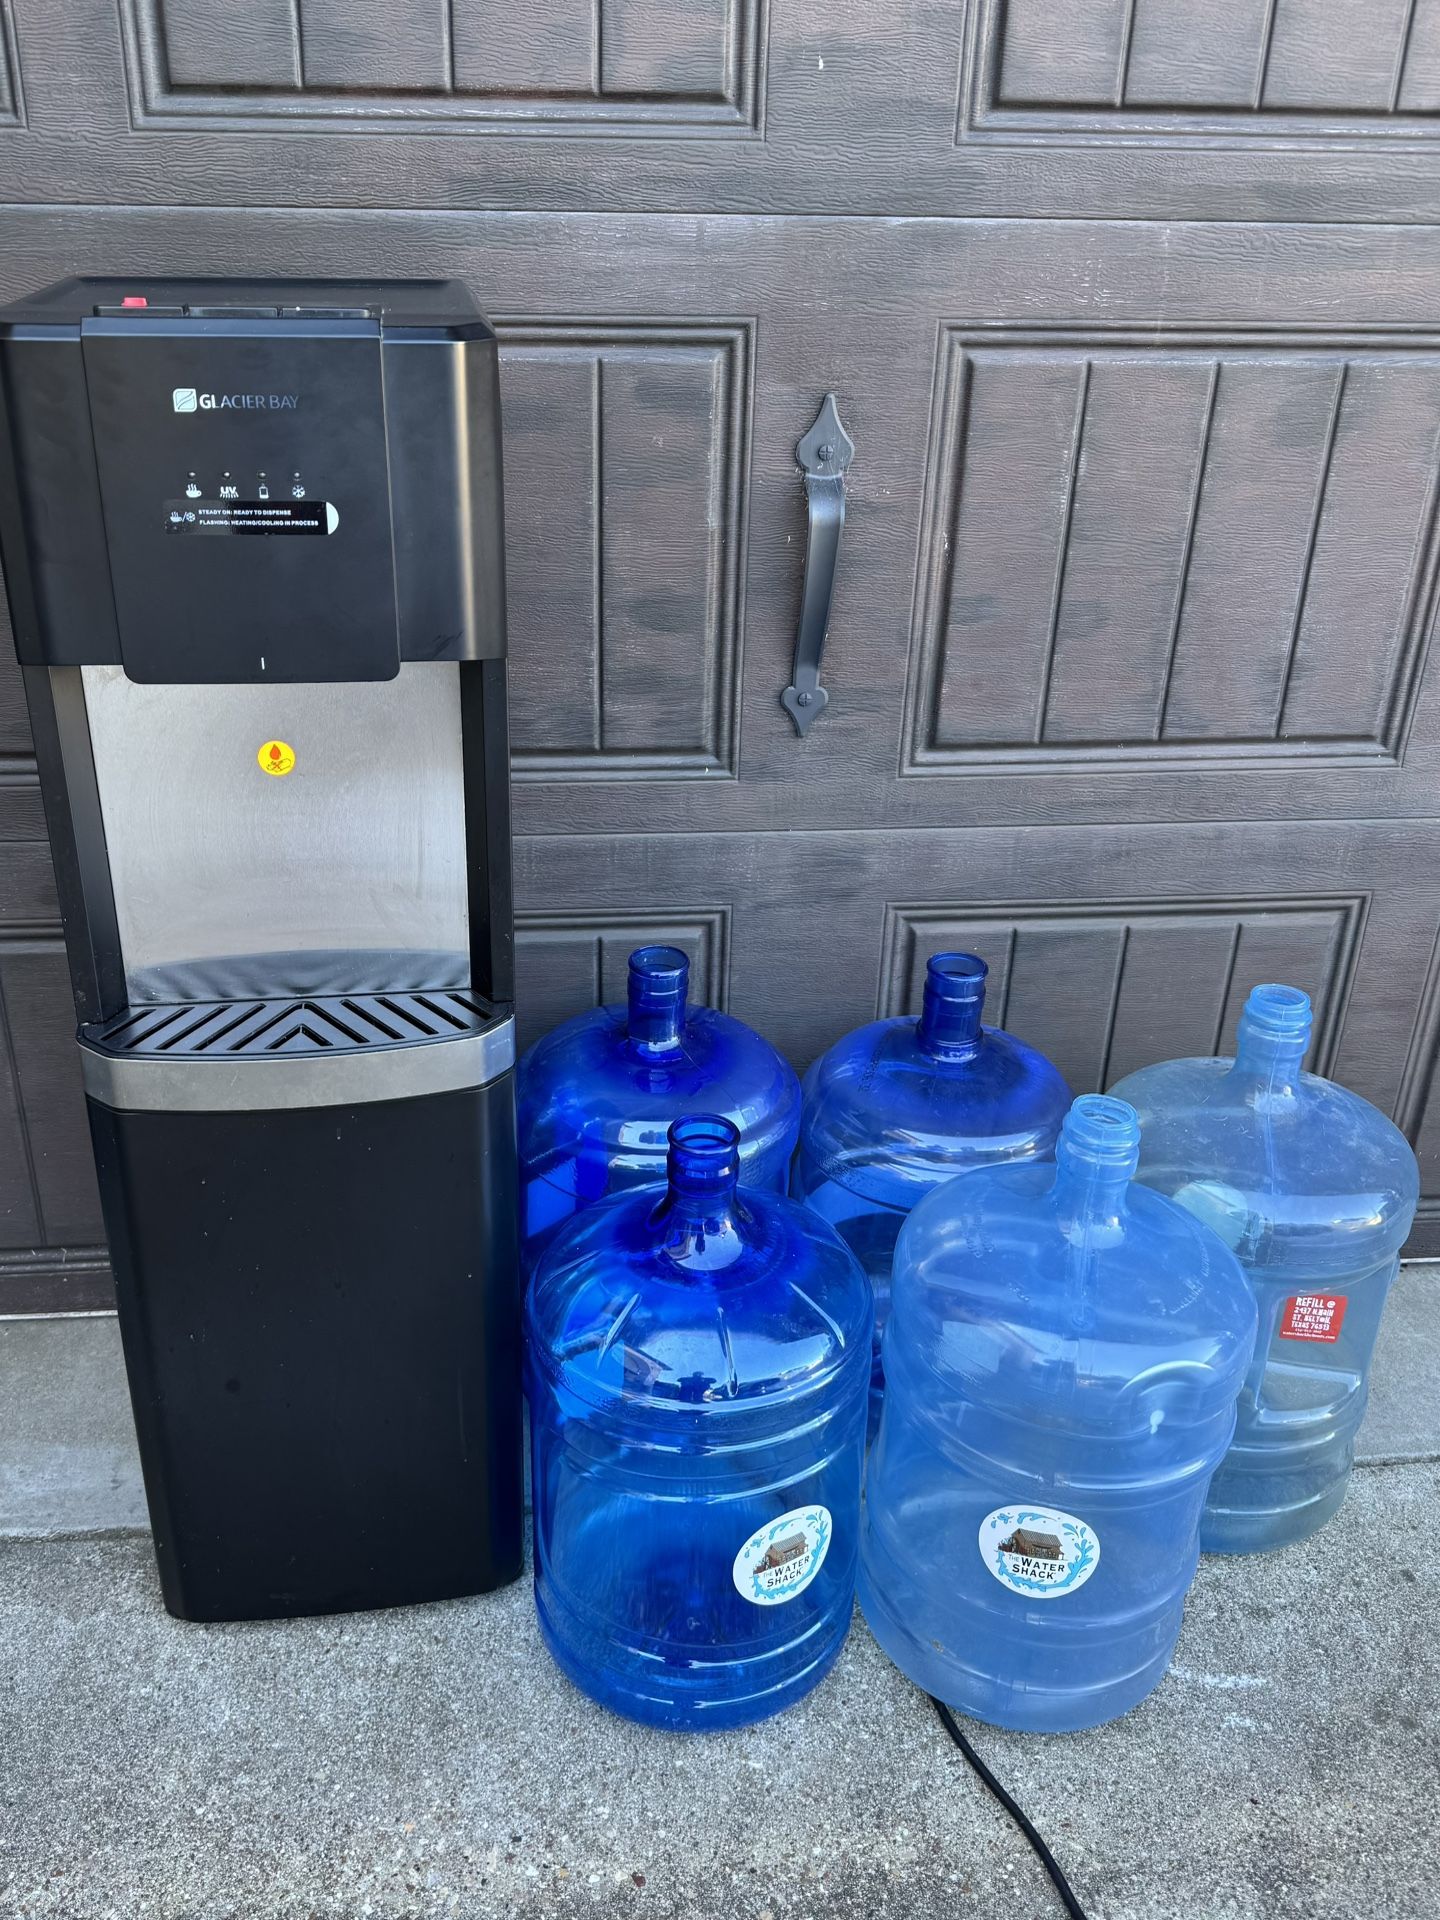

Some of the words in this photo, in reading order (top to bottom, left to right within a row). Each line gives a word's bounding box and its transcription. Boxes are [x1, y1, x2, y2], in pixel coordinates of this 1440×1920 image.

[199, 393, 265, 409] GLACIER
[269, 395, 299, 409] BAY
[1295, 1297, 1324, 1308] REFILL
[1291, 1321, 1309, 1329] TEXAS
[1310, 1323, 1330, 1331] 76513
[774, 1555, 810, 1577] WATER
[1008, 1554, 1020, 1562] THE
[1021, 1557, 1065, 1572] WATER
[766, 1568, 803, 1588] SHACK
[1012, 1564, 1055, 1580] SHACK
